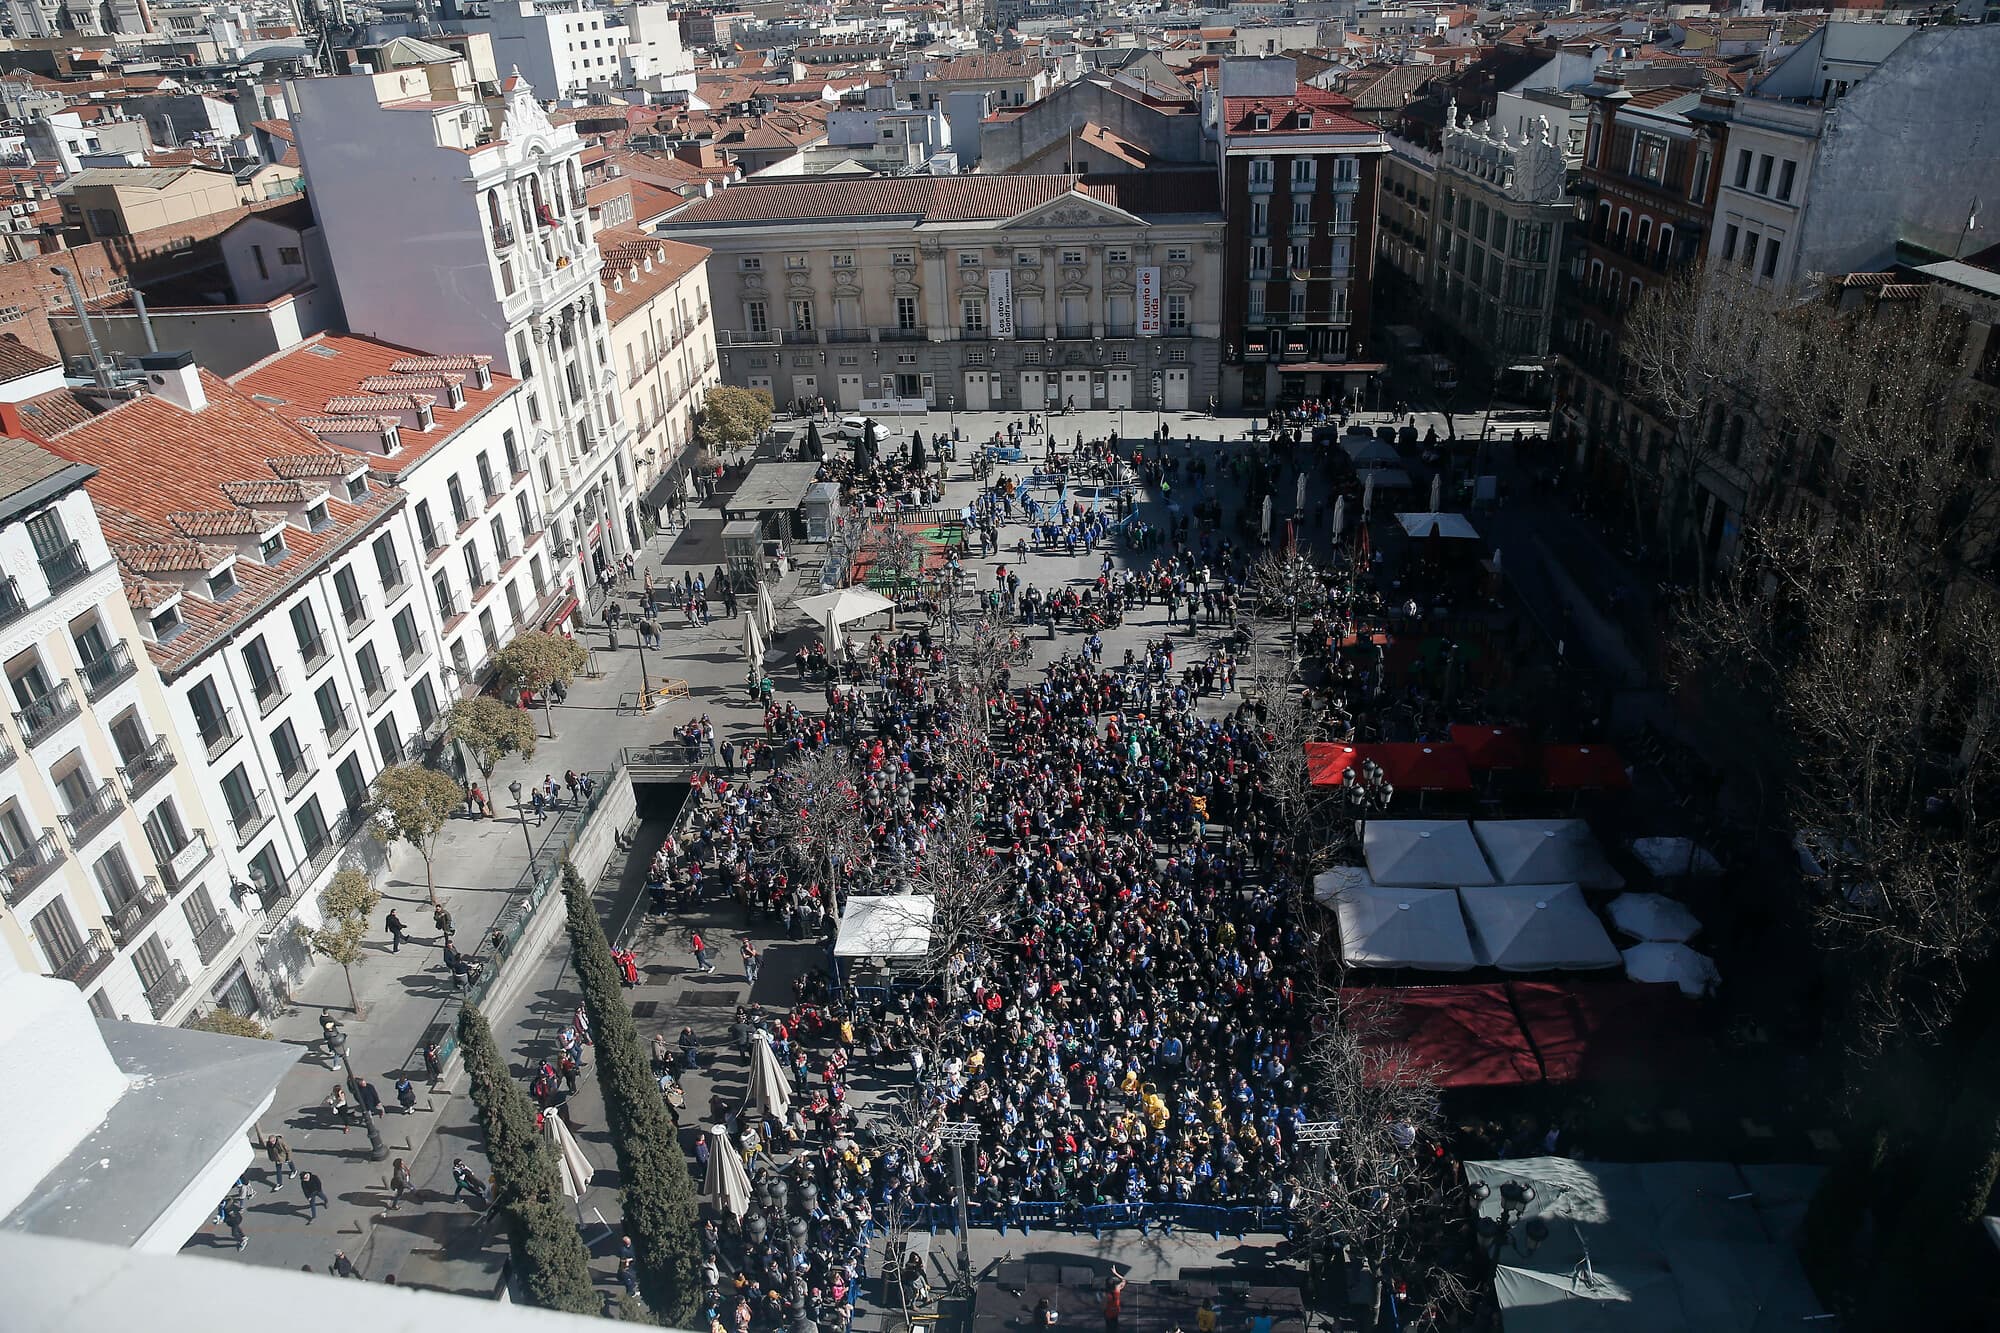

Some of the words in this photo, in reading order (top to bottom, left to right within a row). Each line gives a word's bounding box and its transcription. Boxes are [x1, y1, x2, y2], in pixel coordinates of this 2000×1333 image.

[1142, 272, 1150, 285] de
[1142, 320, 1150, 331] El
[1151, 321, 1158, 330] la
